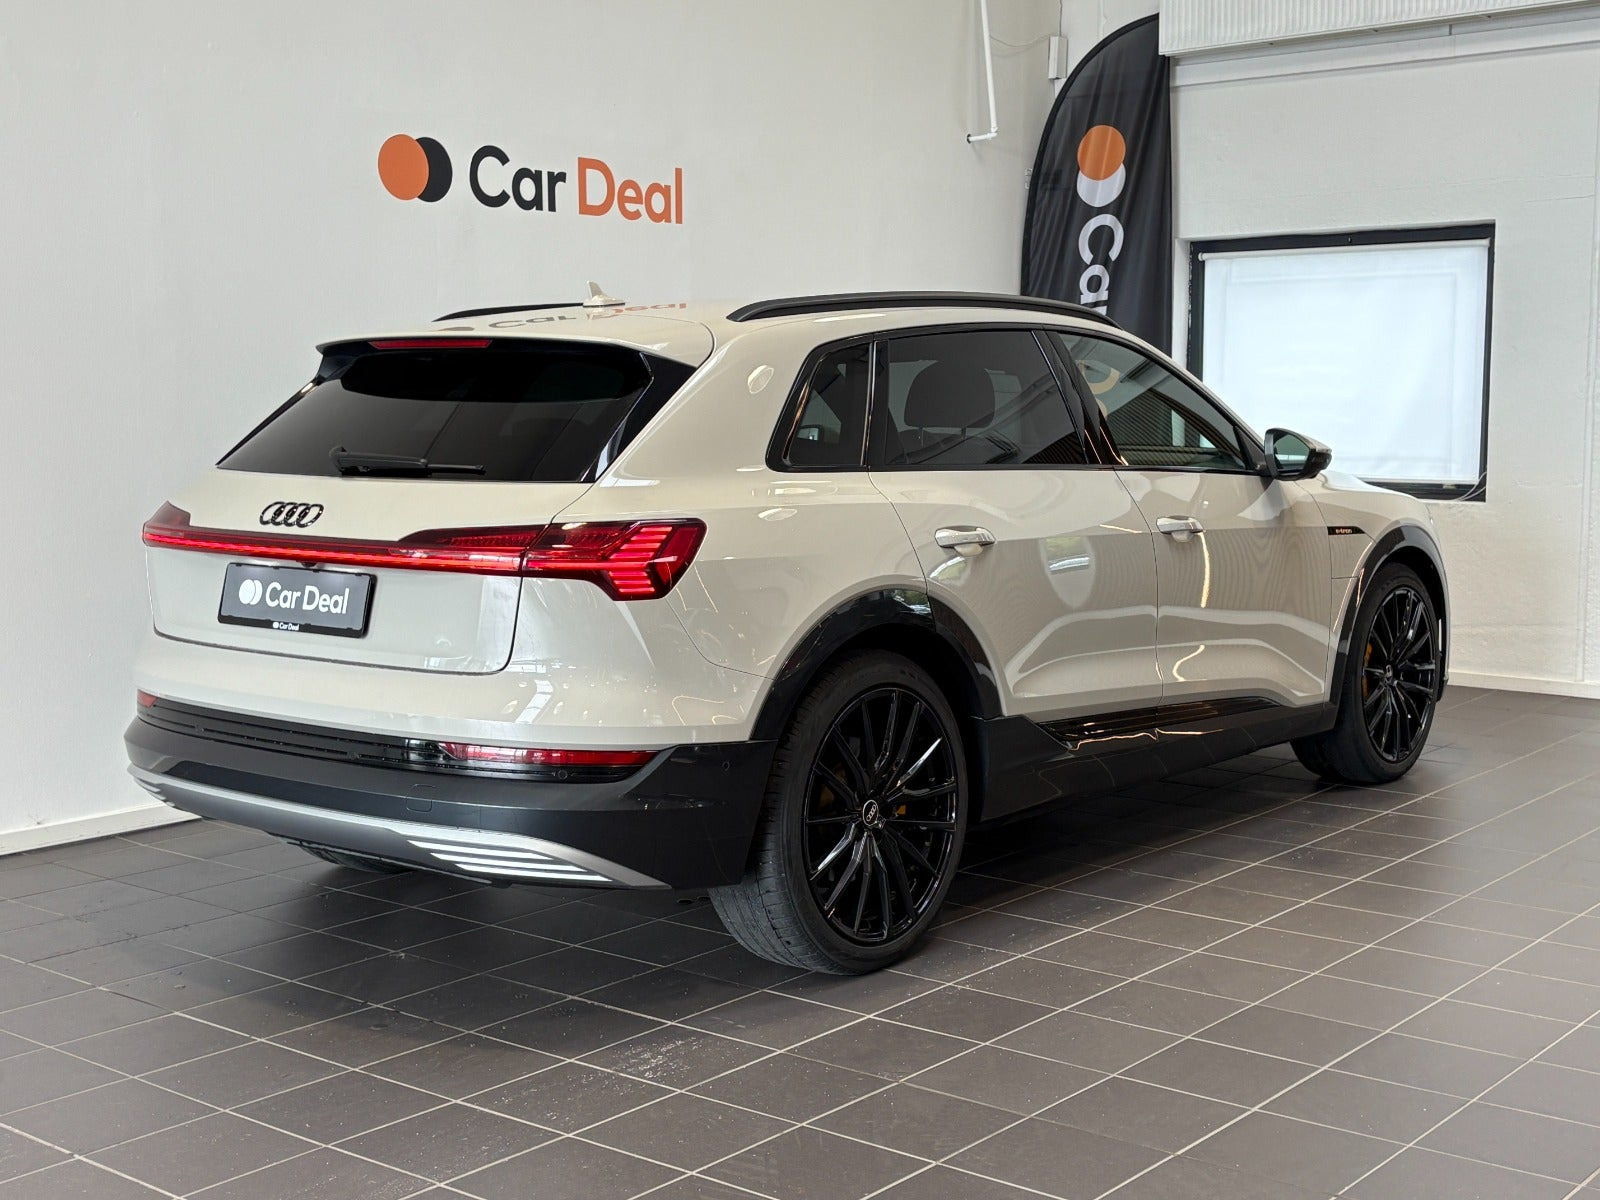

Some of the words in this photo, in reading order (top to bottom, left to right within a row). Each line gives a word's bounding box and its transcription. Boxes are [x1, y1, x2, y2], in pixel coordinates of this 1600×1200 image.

[469, 145, 567, 212] Car
[577, 156, 683, 224] Deal
[265, 582, 301, 609] Car
[302, 585, 350, 614] Deal
[288, 623, 299, 631] Deal
